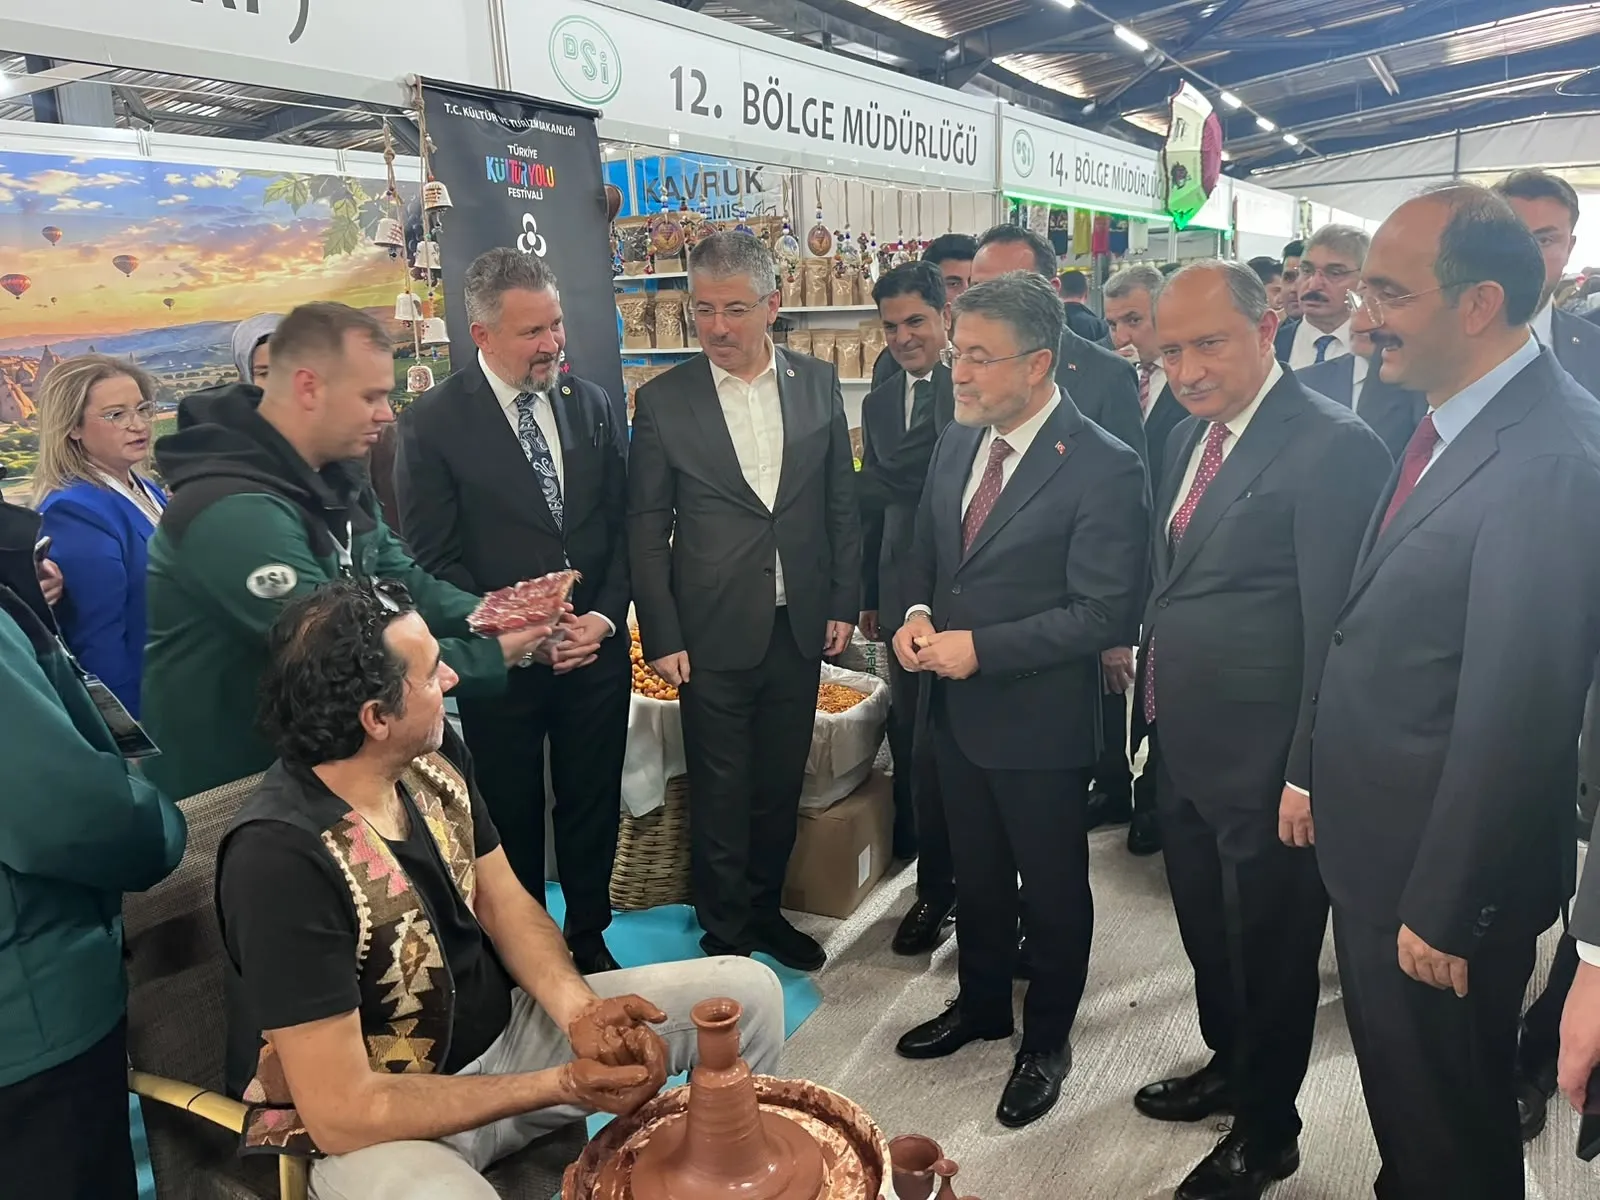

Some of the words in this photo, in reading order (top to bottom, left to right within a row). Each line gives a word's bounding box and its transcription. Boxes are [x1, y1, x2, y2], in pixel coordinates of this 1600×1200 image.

[443, 102, 462, 116] T.C.
[462, 106, 499, 123] KÜLTÜR
[538, 120, 576, 137] AKANLIĞI
[669, 65, 723, 119] 12.
[742, 75, 835, 141] BÖLGE
[842, 101, 978, 166] MÜDÜRLÜĞÜ
[507, 143, 538, 160] TÜRKİYE
[1049, 150, 1069, 187] 14.
[1074, 152, 1110, 188] BÖLGE
[527, 163, 556, 188] YOLU
[645, 165, 766, 204] KAVRUK
[507, 186, 544, 201] FESTİVALİ
